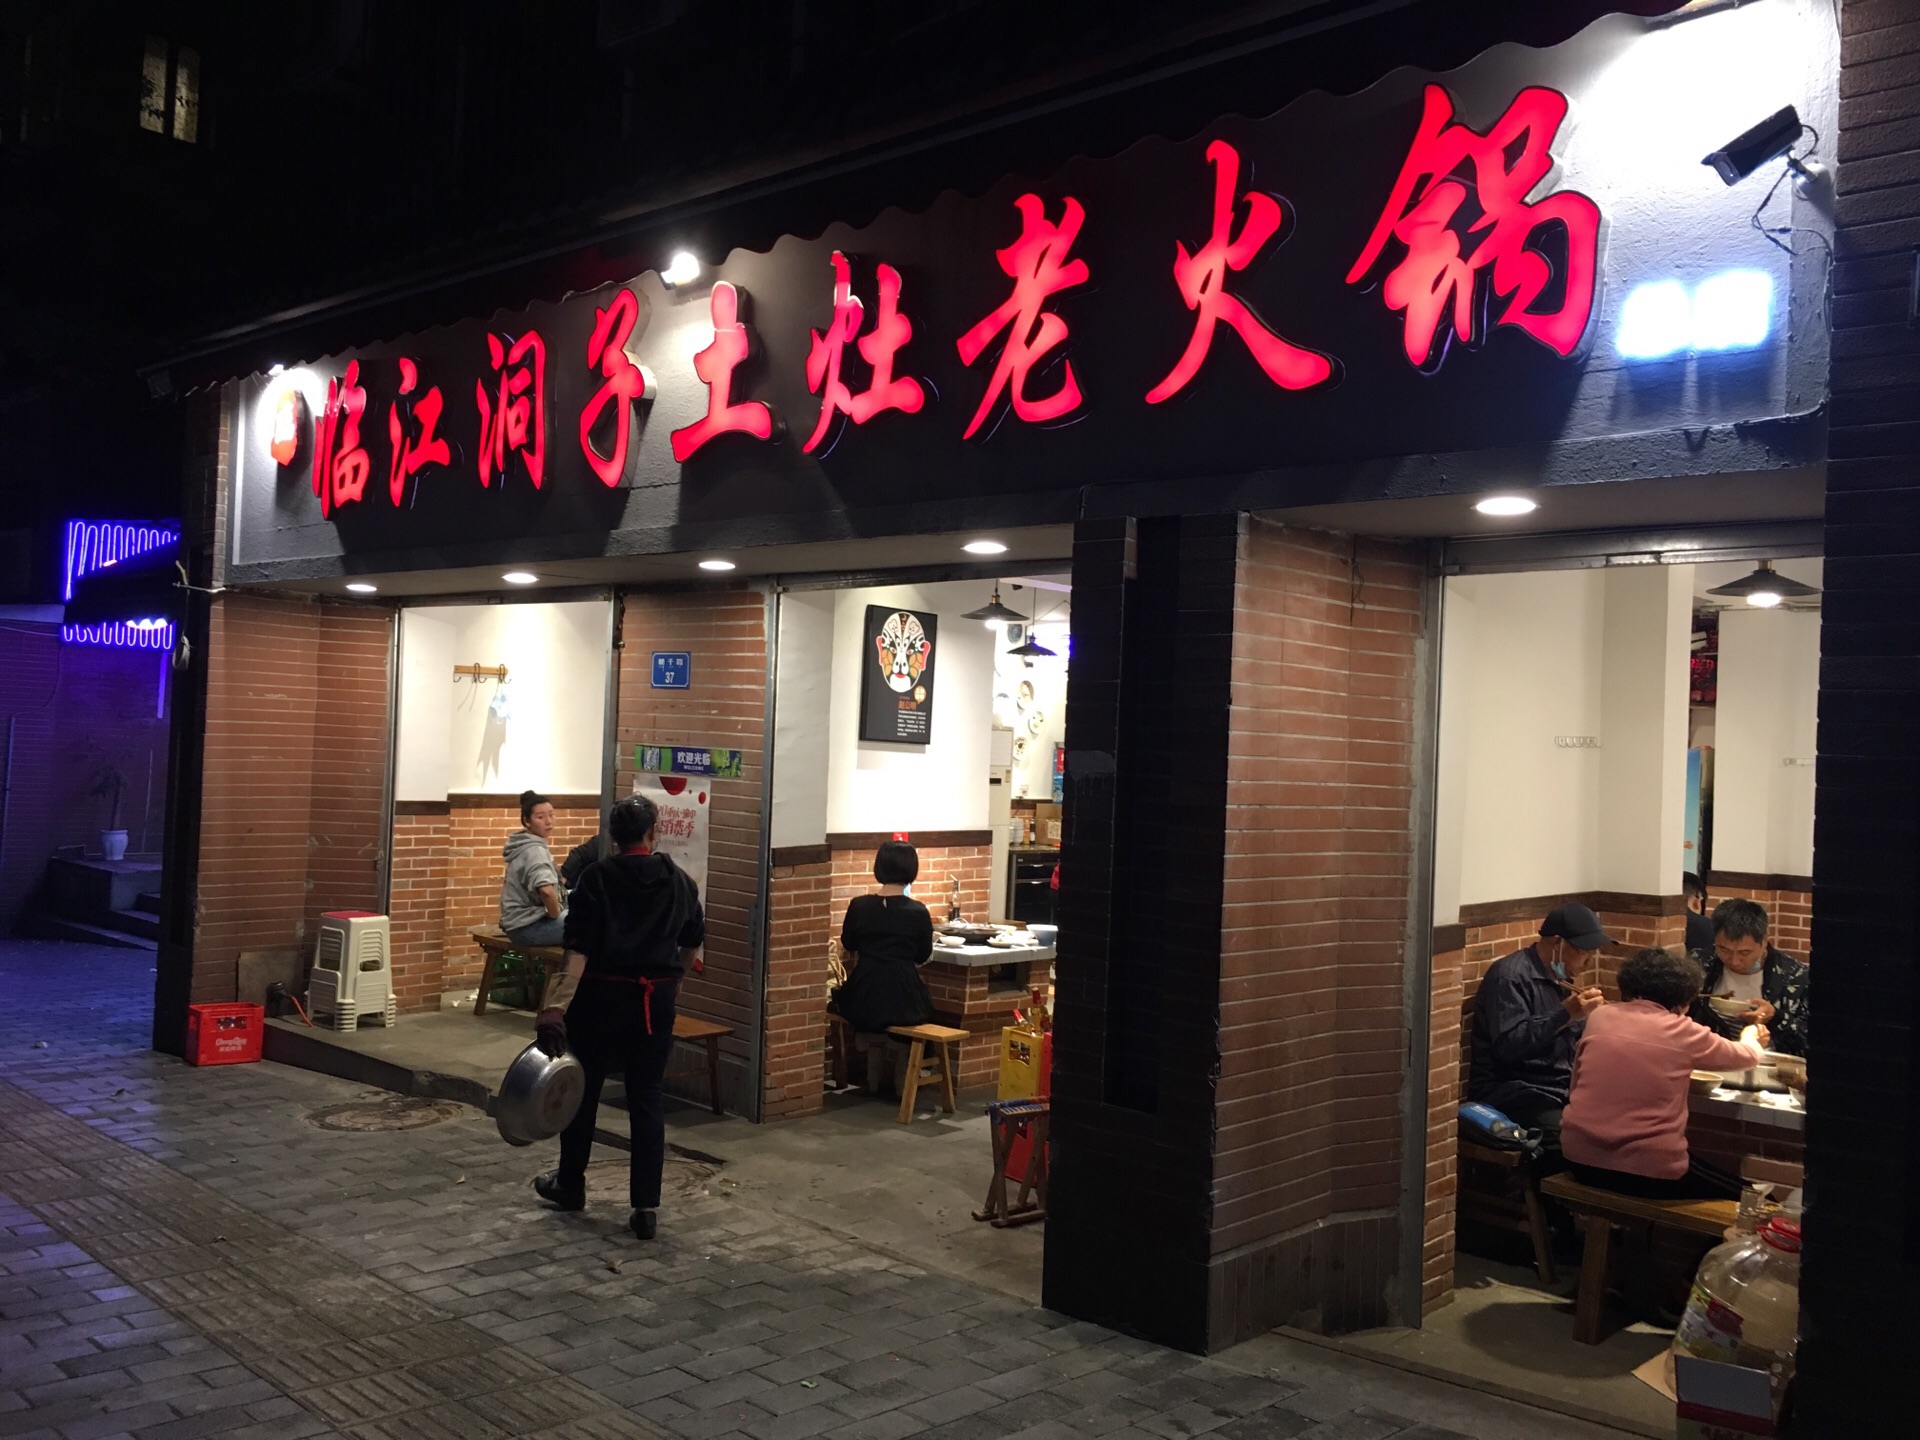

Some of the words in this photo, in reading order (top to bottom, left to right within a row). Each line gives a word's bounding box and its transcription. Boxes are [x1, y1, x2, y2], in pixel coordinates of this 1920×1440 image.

[311, 84, 1600, 520] 临江洞子土灶老火锅
[665, 672, 674, 683] 37
[677, 751, 710, 765] 欢迎光临
